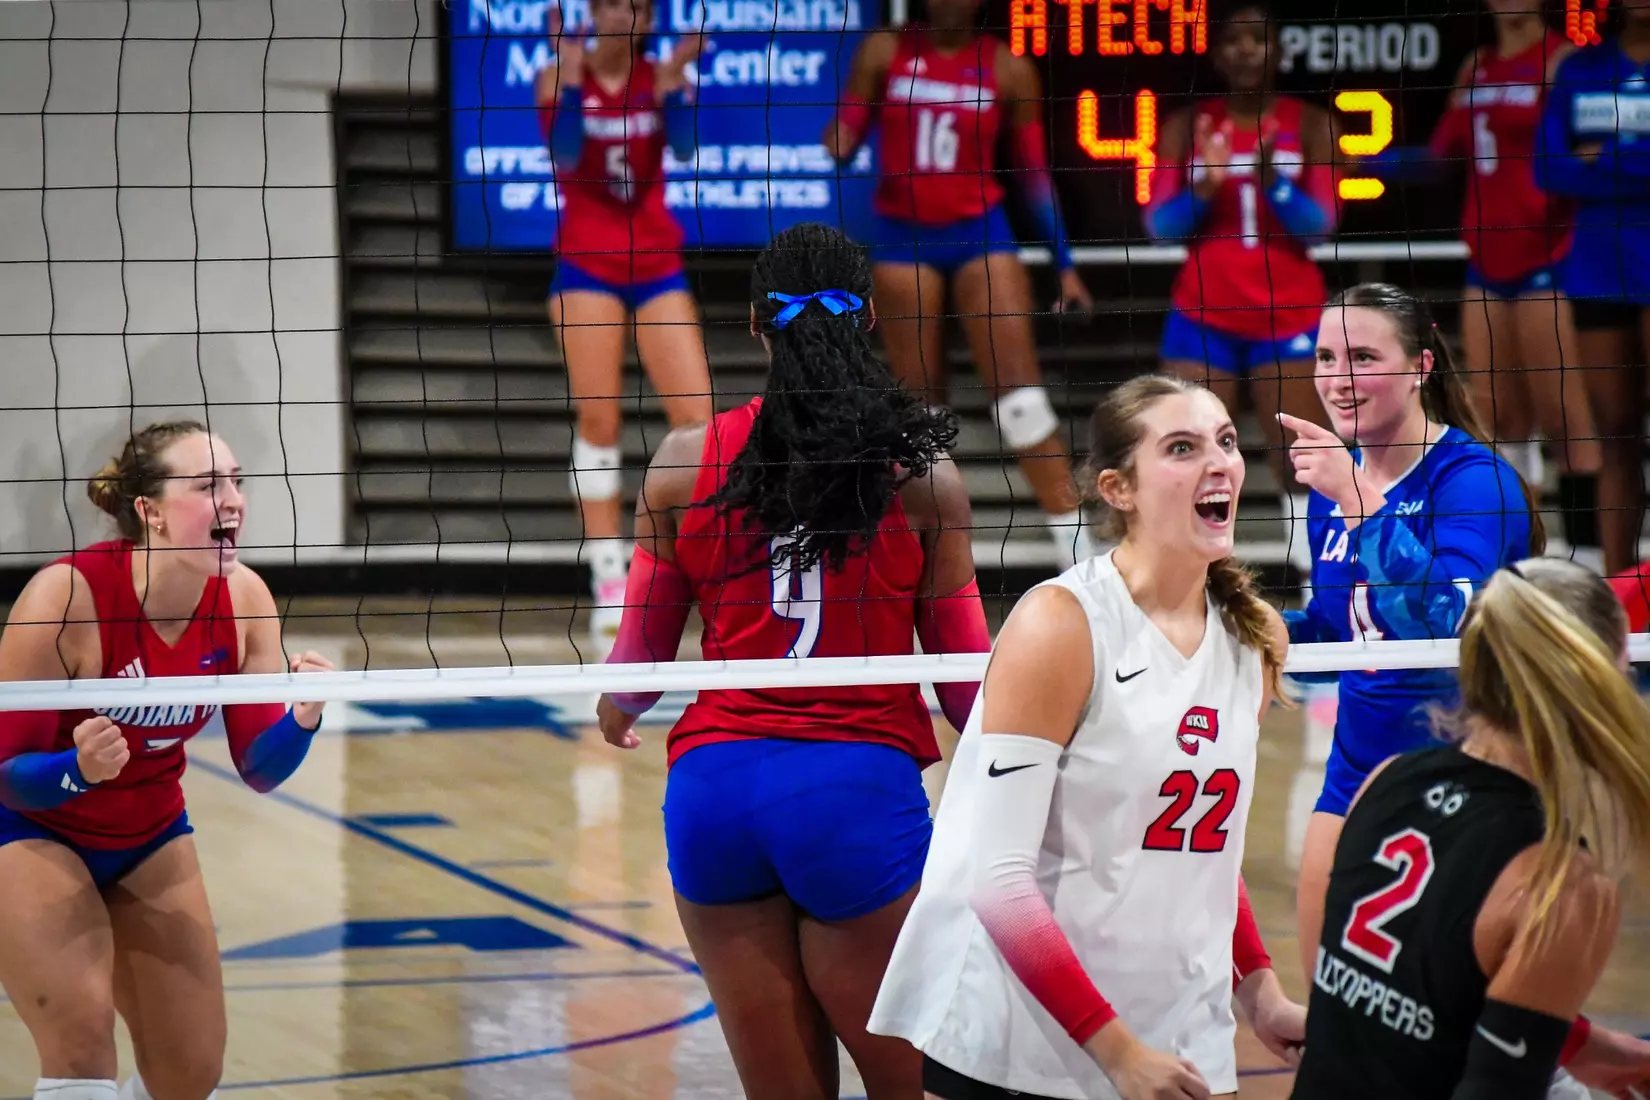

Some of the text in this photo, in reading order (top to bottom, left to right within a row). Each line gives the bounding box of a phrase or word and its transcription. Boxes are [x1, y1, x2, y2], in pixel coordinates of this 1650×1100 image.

[1279, 24, 1440, 72] PERIOD
[916, 108, 959, 171] 16
[1077, 88, 1157, 205] 4
[1335, 90, 1393, 200] 2
[1319, 529, 1350, 563] LA
[1141, 768, 1241, 853] 22
[1340, 828, 1436, 976] 2
